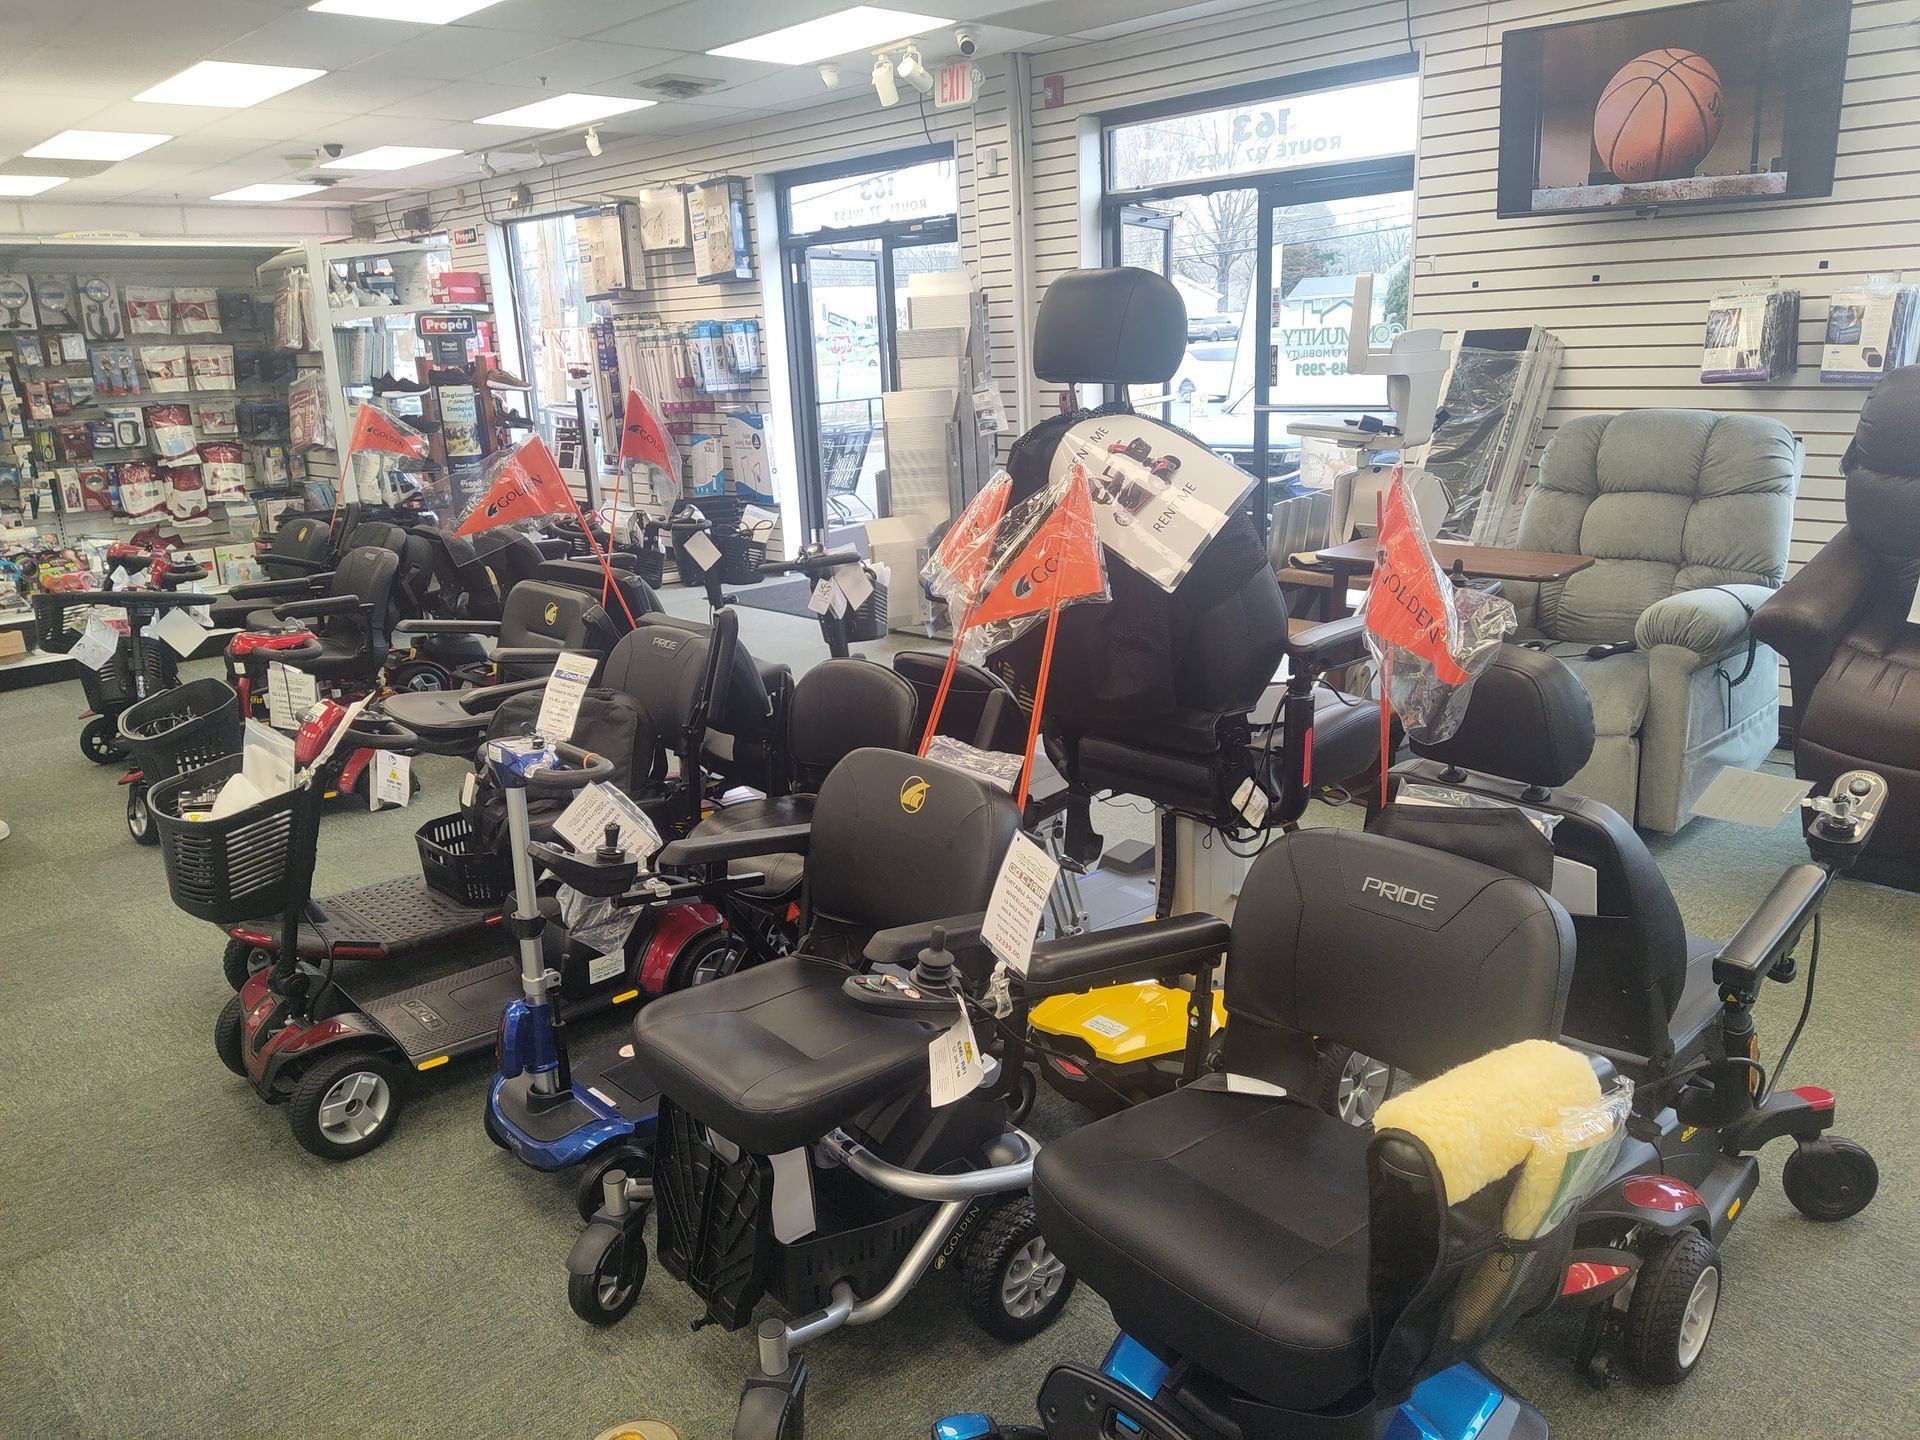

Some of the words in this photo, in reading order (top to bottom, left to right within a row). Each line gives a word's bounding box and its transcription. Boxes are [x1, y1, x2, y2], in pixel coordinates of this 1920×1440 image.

[941, 64, 967, 104] EXIT
[425, 319, 468, 332] Propét
[1270, 346, 1278, 386] PUSH
[372, 428, 405, 449] GOLDEN
[1089, 426, 1110, 444] ME
[1152, 501, 1181, 533] RENT
[1177, 481, 1198, 502] ME
[652, 636, 678, 651] PRIDE
[595, 807, 616, 832] LITERIDER
[1004, 875, 1026, 897] PORTABLE
[1027, 894, 1043, 912] POWER
[1021, 875, 1047, 900] CHAIR
[1361, 876, 1439, 911] PRIDE
[1006, 889, 1033, 915] WHEELCHAIR
[1011, 915, 1029, 932] CAPACITY
[1018, 911, 1030, 924] RANGE
[997, 923, 1009, 935] YOUR
[1009, 935, 1021, 947] PRICE
[943, 1205, 980, 1256] GOLDEN
